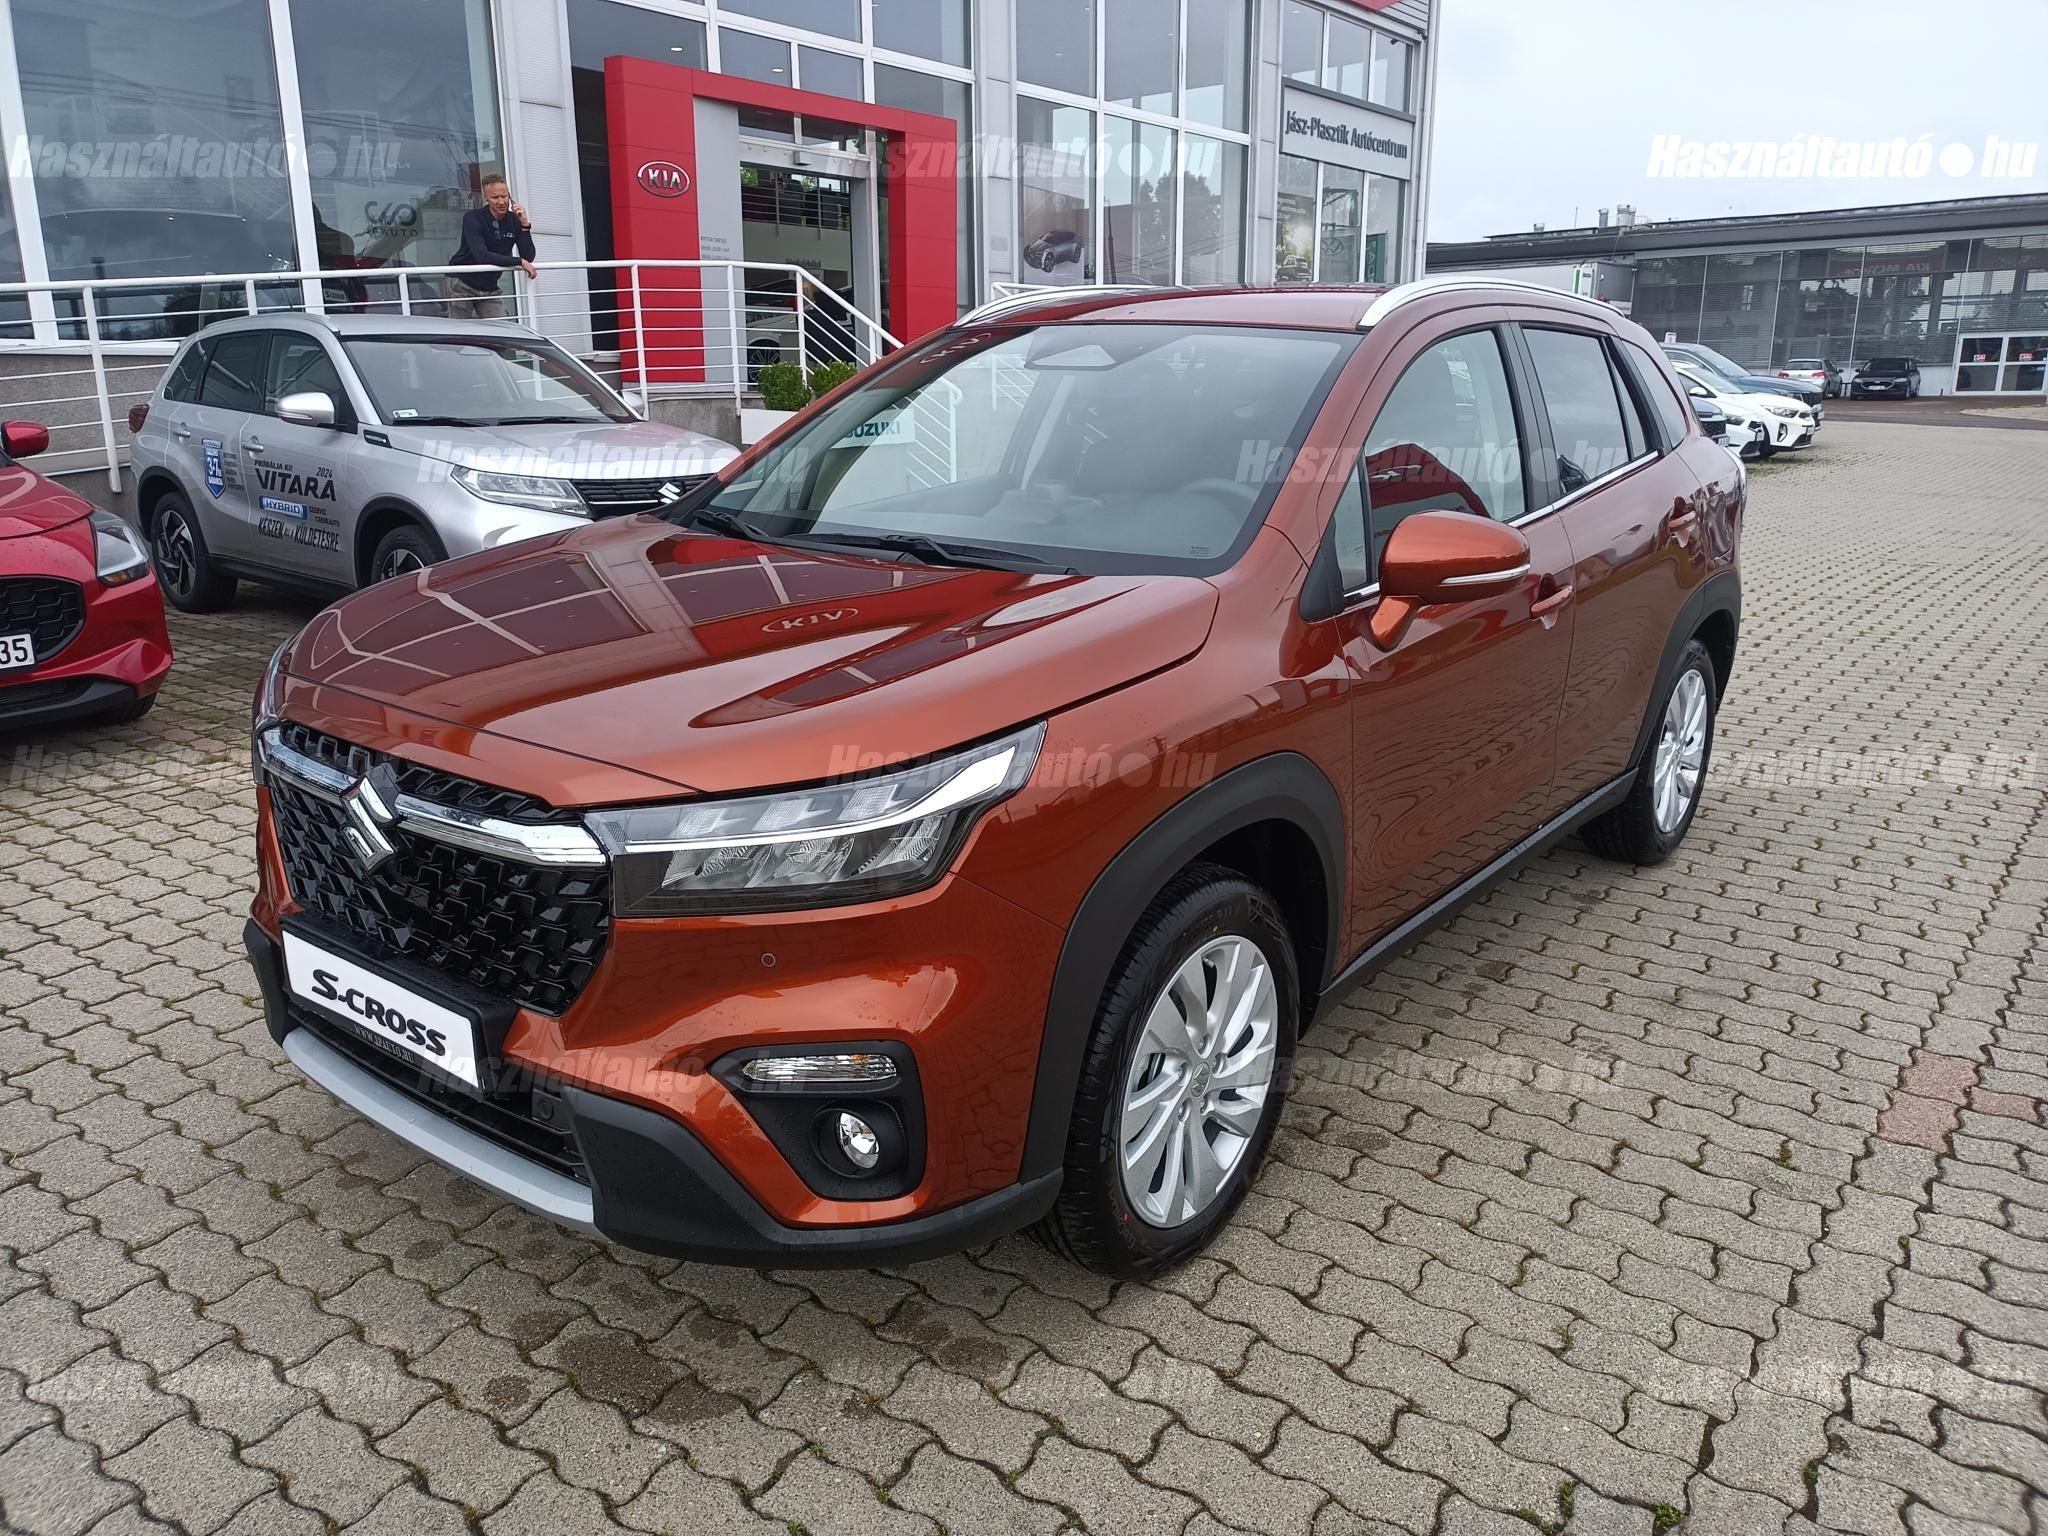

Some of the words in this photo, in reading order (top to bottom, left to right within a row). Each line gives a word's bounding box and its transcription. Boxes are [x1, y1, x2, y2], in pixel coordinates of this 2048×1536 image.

[1285, 110, 1349, 145] Jász-Plasztik
[1350, 128, 1407, 159] Autócentrum
[648, 168, 682, 189] KIA
[255, 468, 336, 501] VITARA
[316, 466, 333, 478] 2024
[265, 499, 301, 515] HYBRID
[258, 517, 285, 540] KÉSZEN
[295, 522, 340, 552] KÜLDETÉSRE
[0, 638, 28, 664] 35
